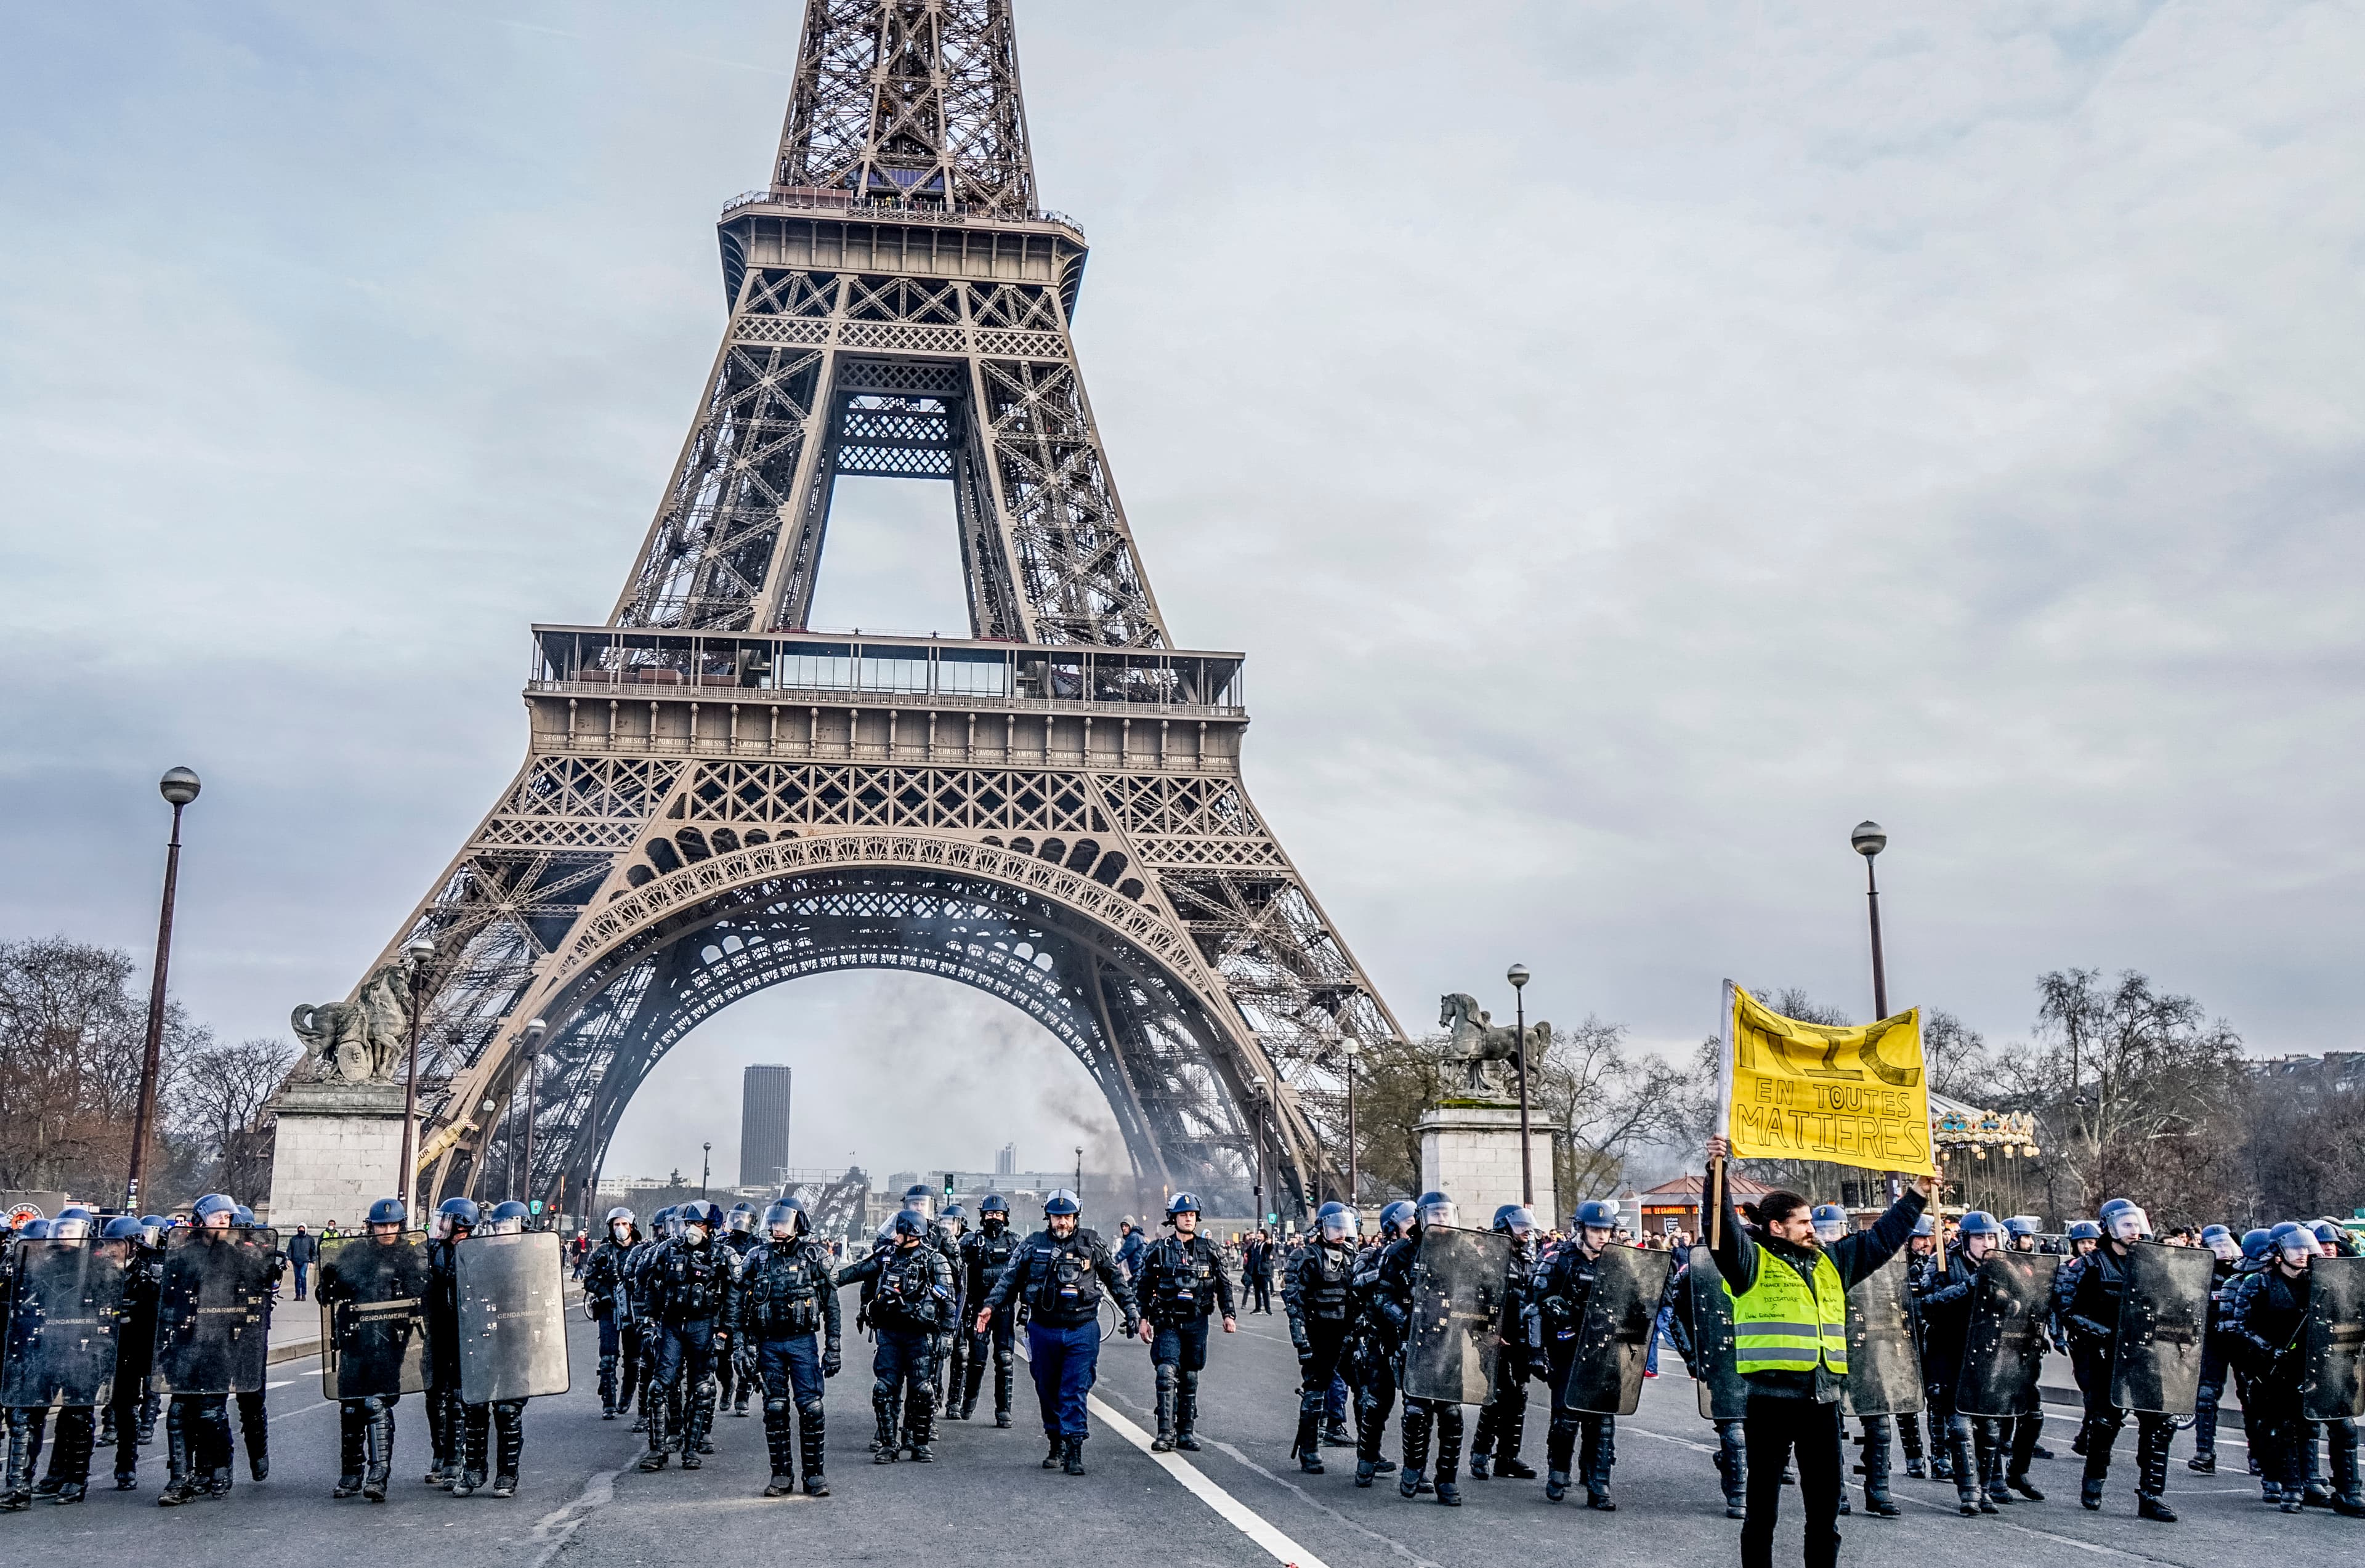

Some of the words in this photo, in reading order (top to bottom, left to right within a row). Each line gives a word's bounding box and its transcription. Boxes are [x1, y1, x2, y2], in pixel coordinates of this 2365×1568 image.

[543, 733, 567, 742] SEGUIN
[580, 735, 607, 743] LALANDE
[621, 737, 647, 745] TRESCA
[701, 739, 727, 747] BRESSE
[778, 742, 809, 750] BELANGER
[822, 743, 845, 751] CUVIER
[976, 749, 1005, 757] LAVOISIER
[1016, 750, 1042, 758] AMPERE
[1051, 751, 1082, 759] CHEVREUL
[1132, 754, 1154, 762] NAVIER
[1168, 756, 1197, 764] LEGENDRE
[1739, 997, 1920, 1087] RIC
[1755, 1077, 1794, 1105] EN
[1813, 1084, 1911, 1118] TOUTES
[1737, 1104, 1926, 1163] MATIERES
[359, 1312, 409, 1322] GENDARMERIE
[497, 1310, 546, 1320] GENDARMERIE
